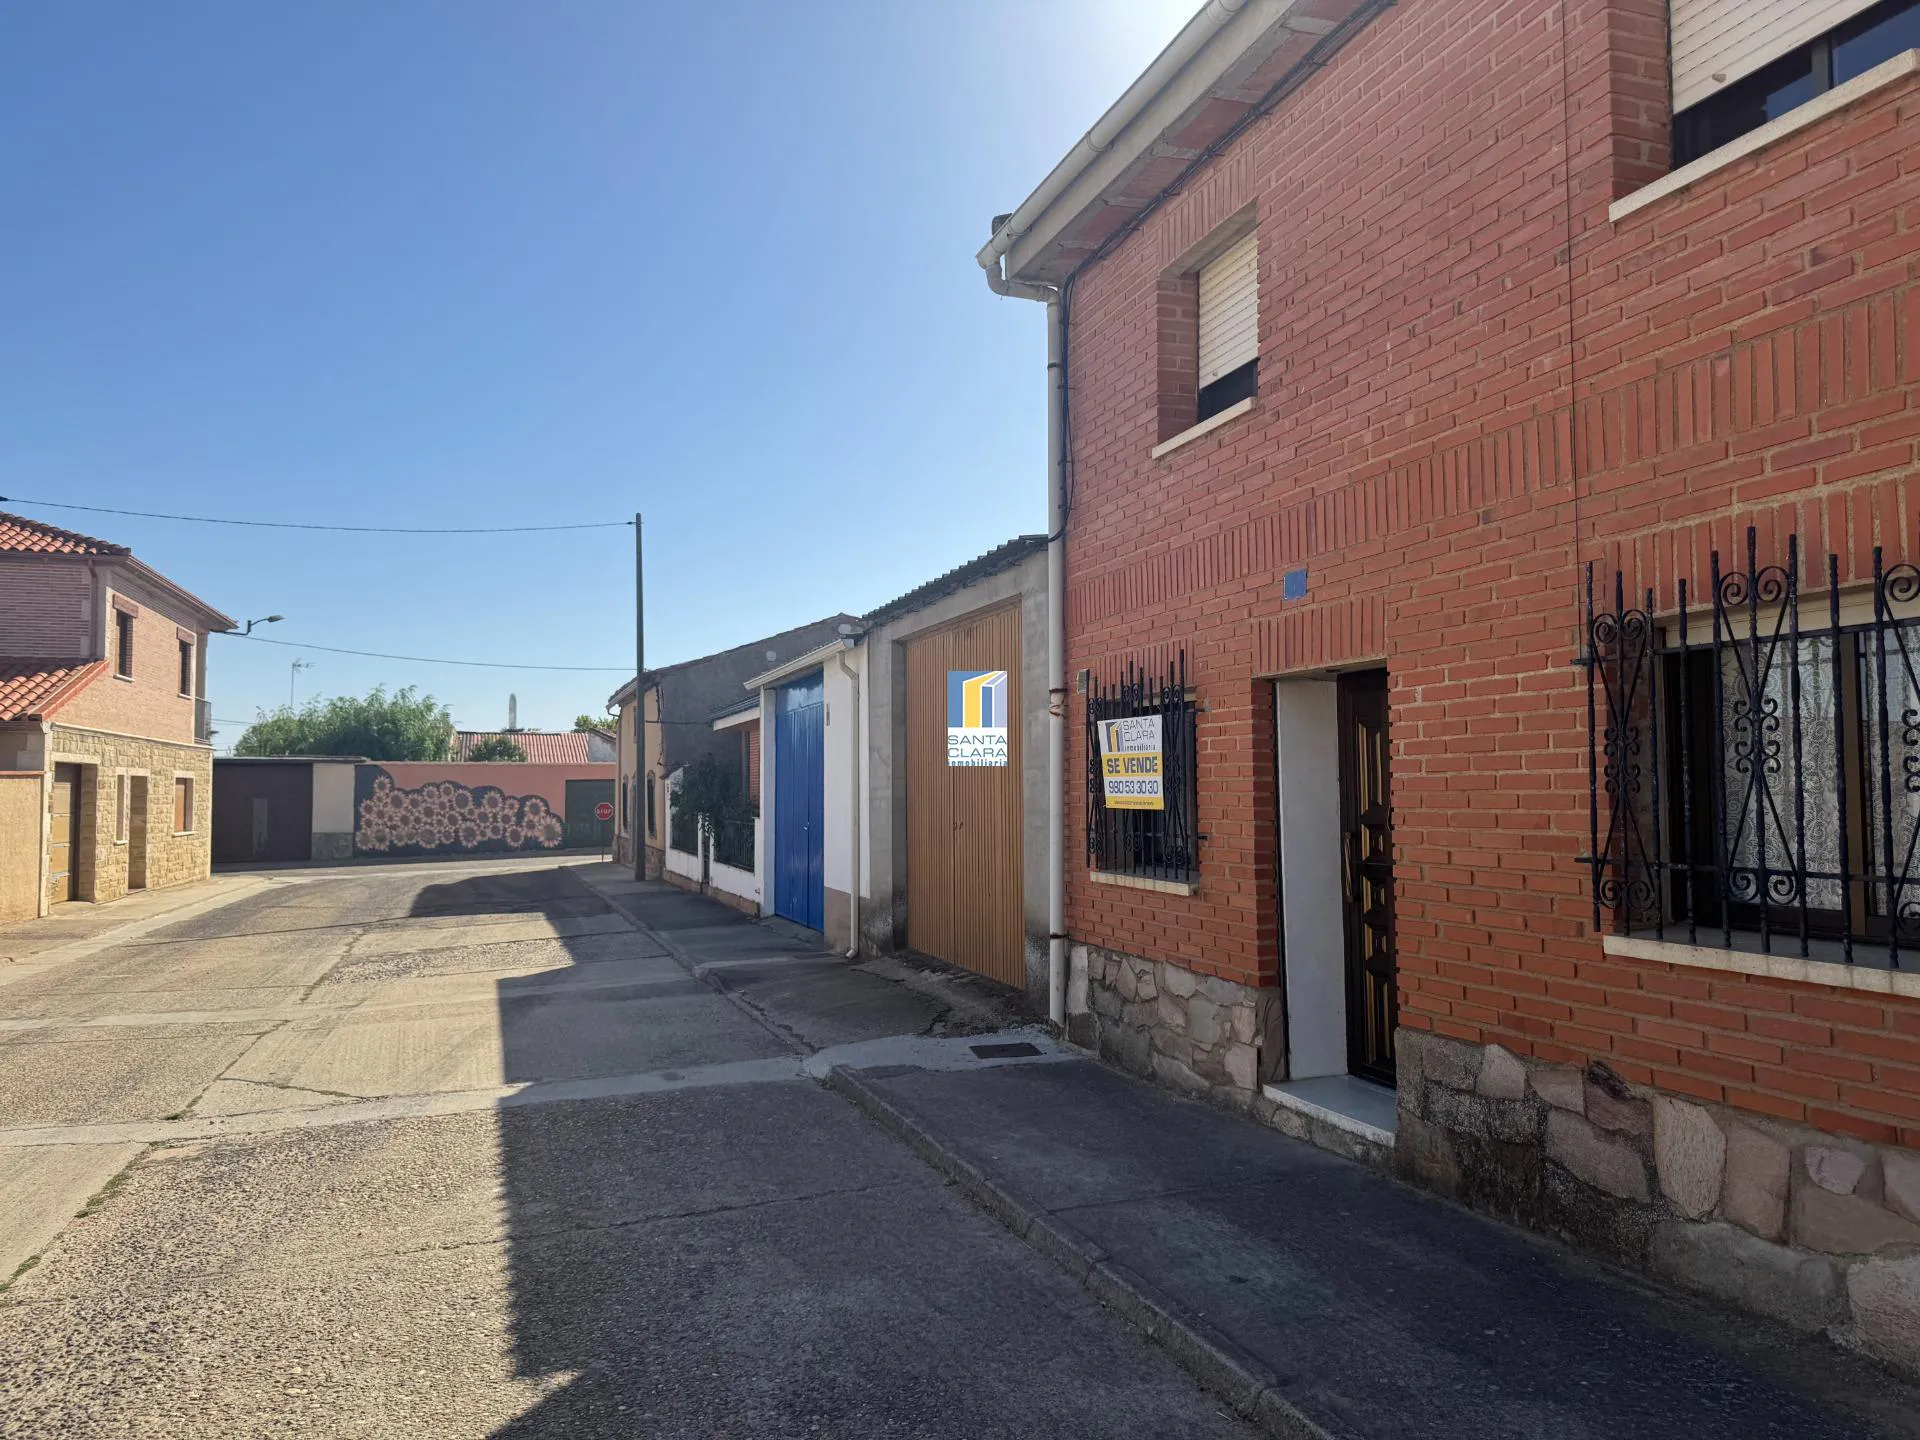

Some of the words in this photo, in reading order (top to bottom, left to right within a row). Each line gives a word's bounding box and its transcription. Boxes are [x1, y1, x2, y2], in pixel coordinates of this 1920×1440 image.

[1123, 718, 1155, 730] SANTA
[1124, 730, 1155, 741] CLARA
[1107, 758, 1120, 774] SE
[1123, 756, 1158, 773] VENDE
[1125, 780, 1135, 794] 53
[1147, 780, 1159, 795] 30
